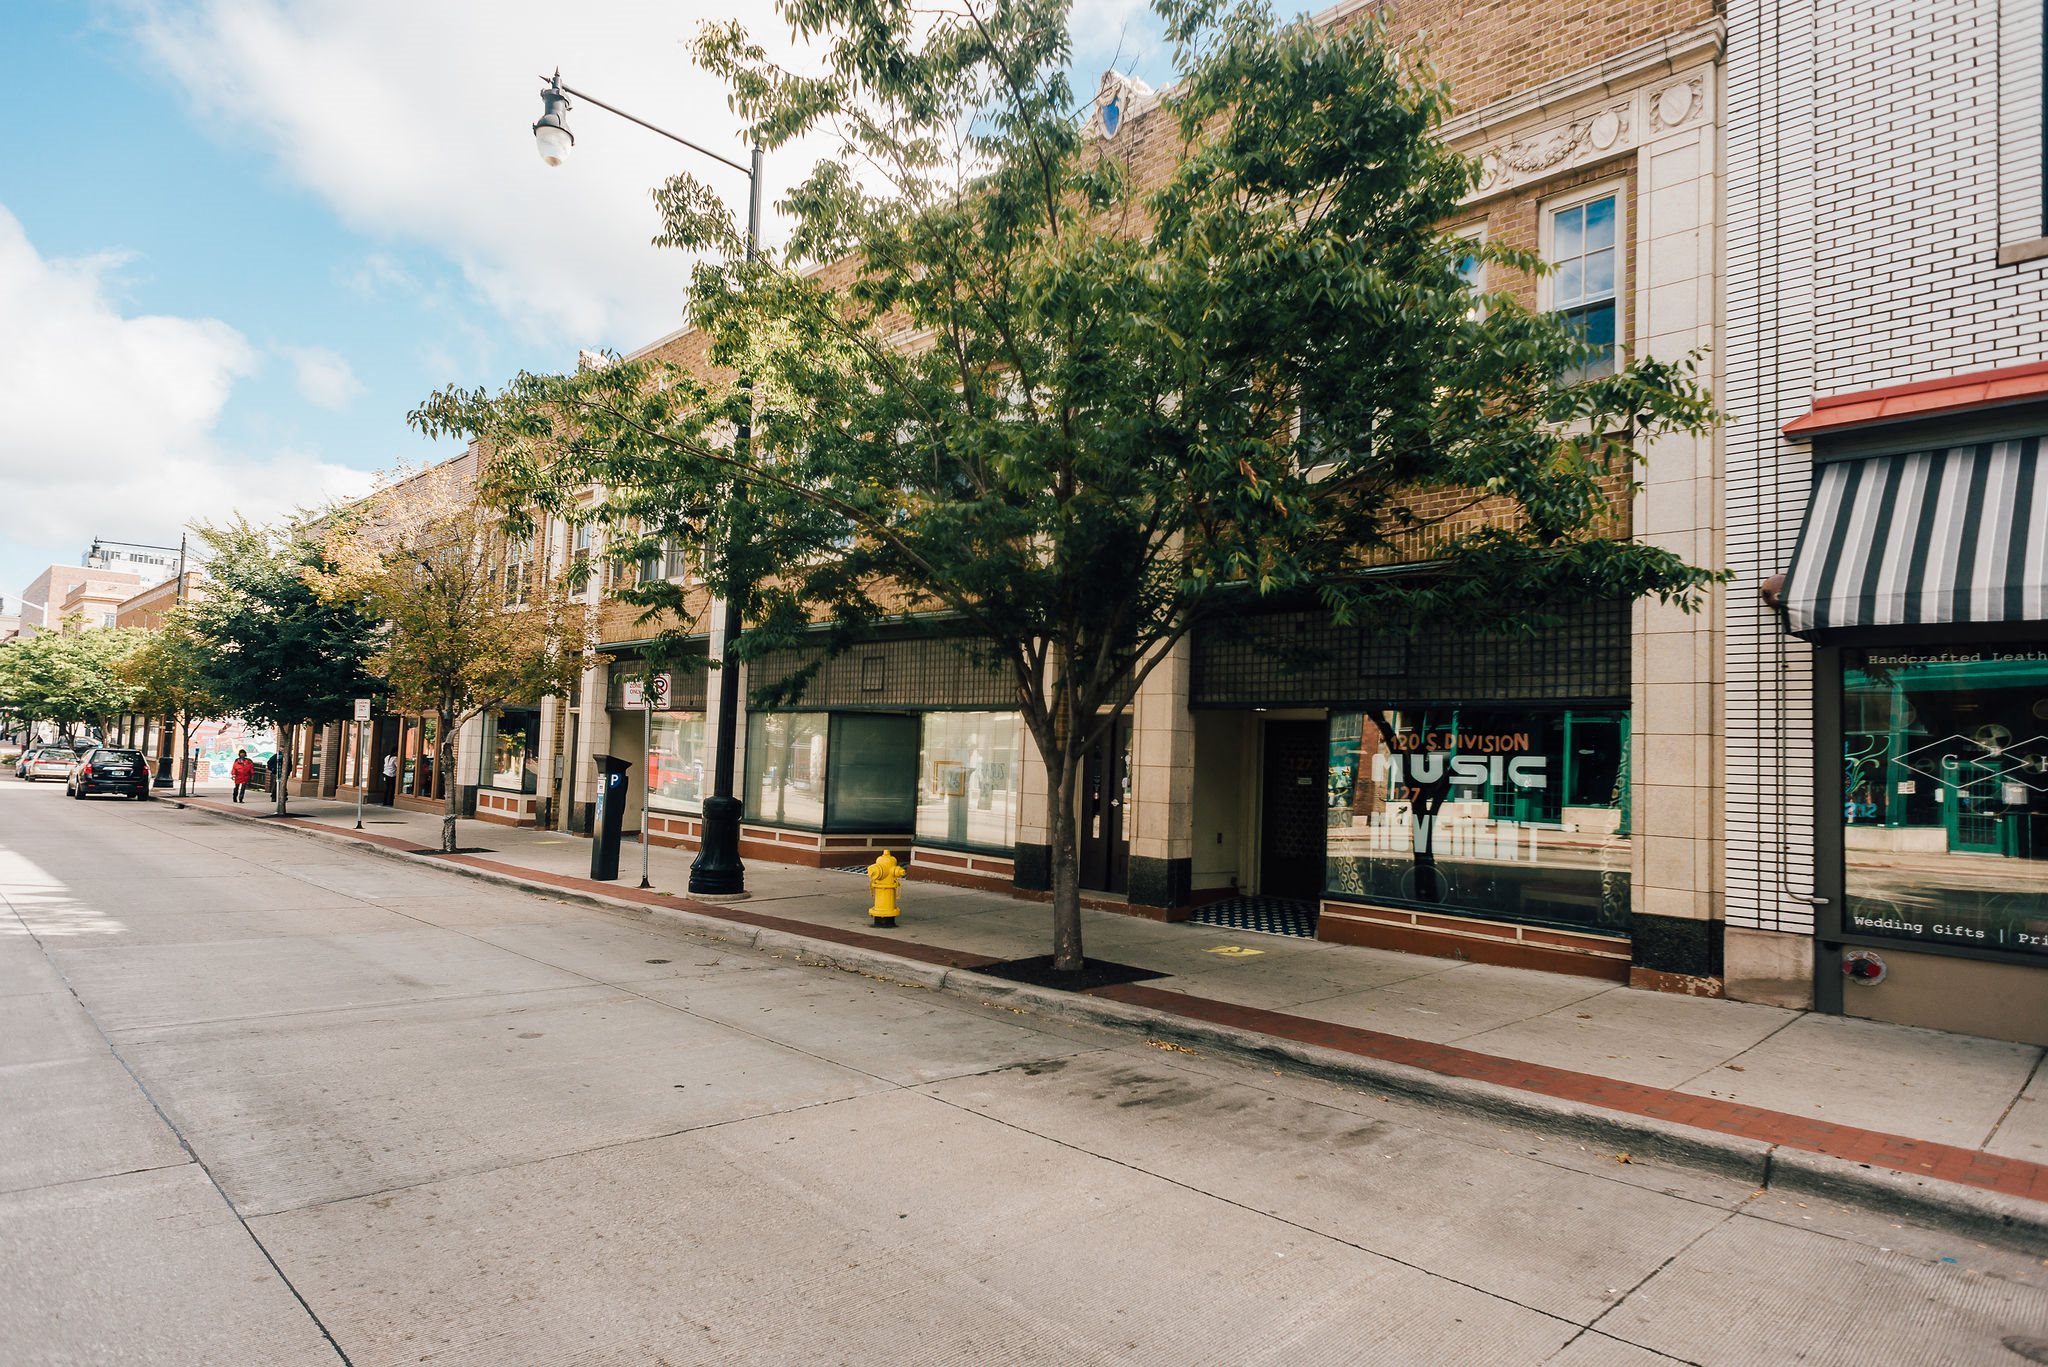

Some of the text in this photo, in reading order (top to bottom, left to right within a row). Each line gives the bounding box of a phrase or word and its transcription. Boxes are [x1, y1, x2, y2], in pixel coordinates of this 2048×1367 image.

[1868, 652, 1981, 664] Handcrafted
[1390, 733, 1529, 753] 120 S. DIVISION
[1371, 753, 1547, 788] MUSIC
[1941, 753, 1959, 770] G
[610, 773, 619, 786] P
[1370, 811, 1546, 863] MOVEMENT
[1854, 916, 1923, 934] Wedding
[1932, 924, 1985, 939] Gifts
